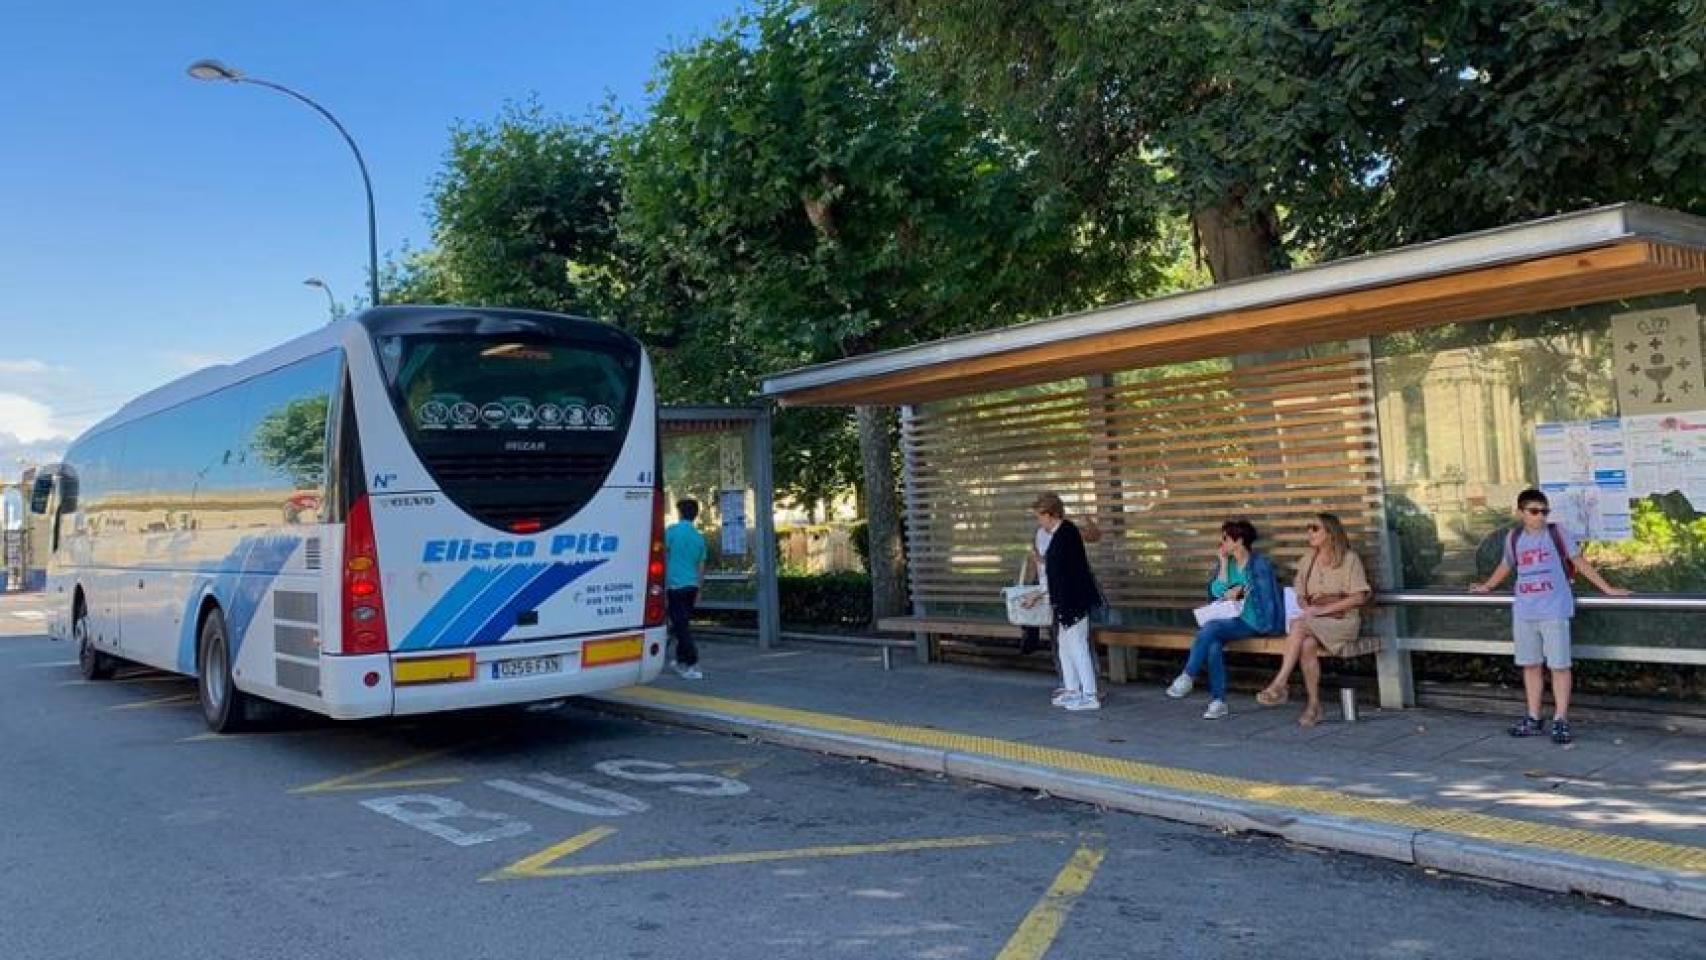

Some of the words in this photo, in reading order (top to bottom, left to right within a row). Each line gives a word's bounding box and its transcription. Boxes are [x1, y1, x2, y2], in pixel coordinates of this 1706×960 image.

[423, 539, 536, 562] Eliseo
[552, 532, 620, 555] Pita
[359, 757, 751, 847] BUS
